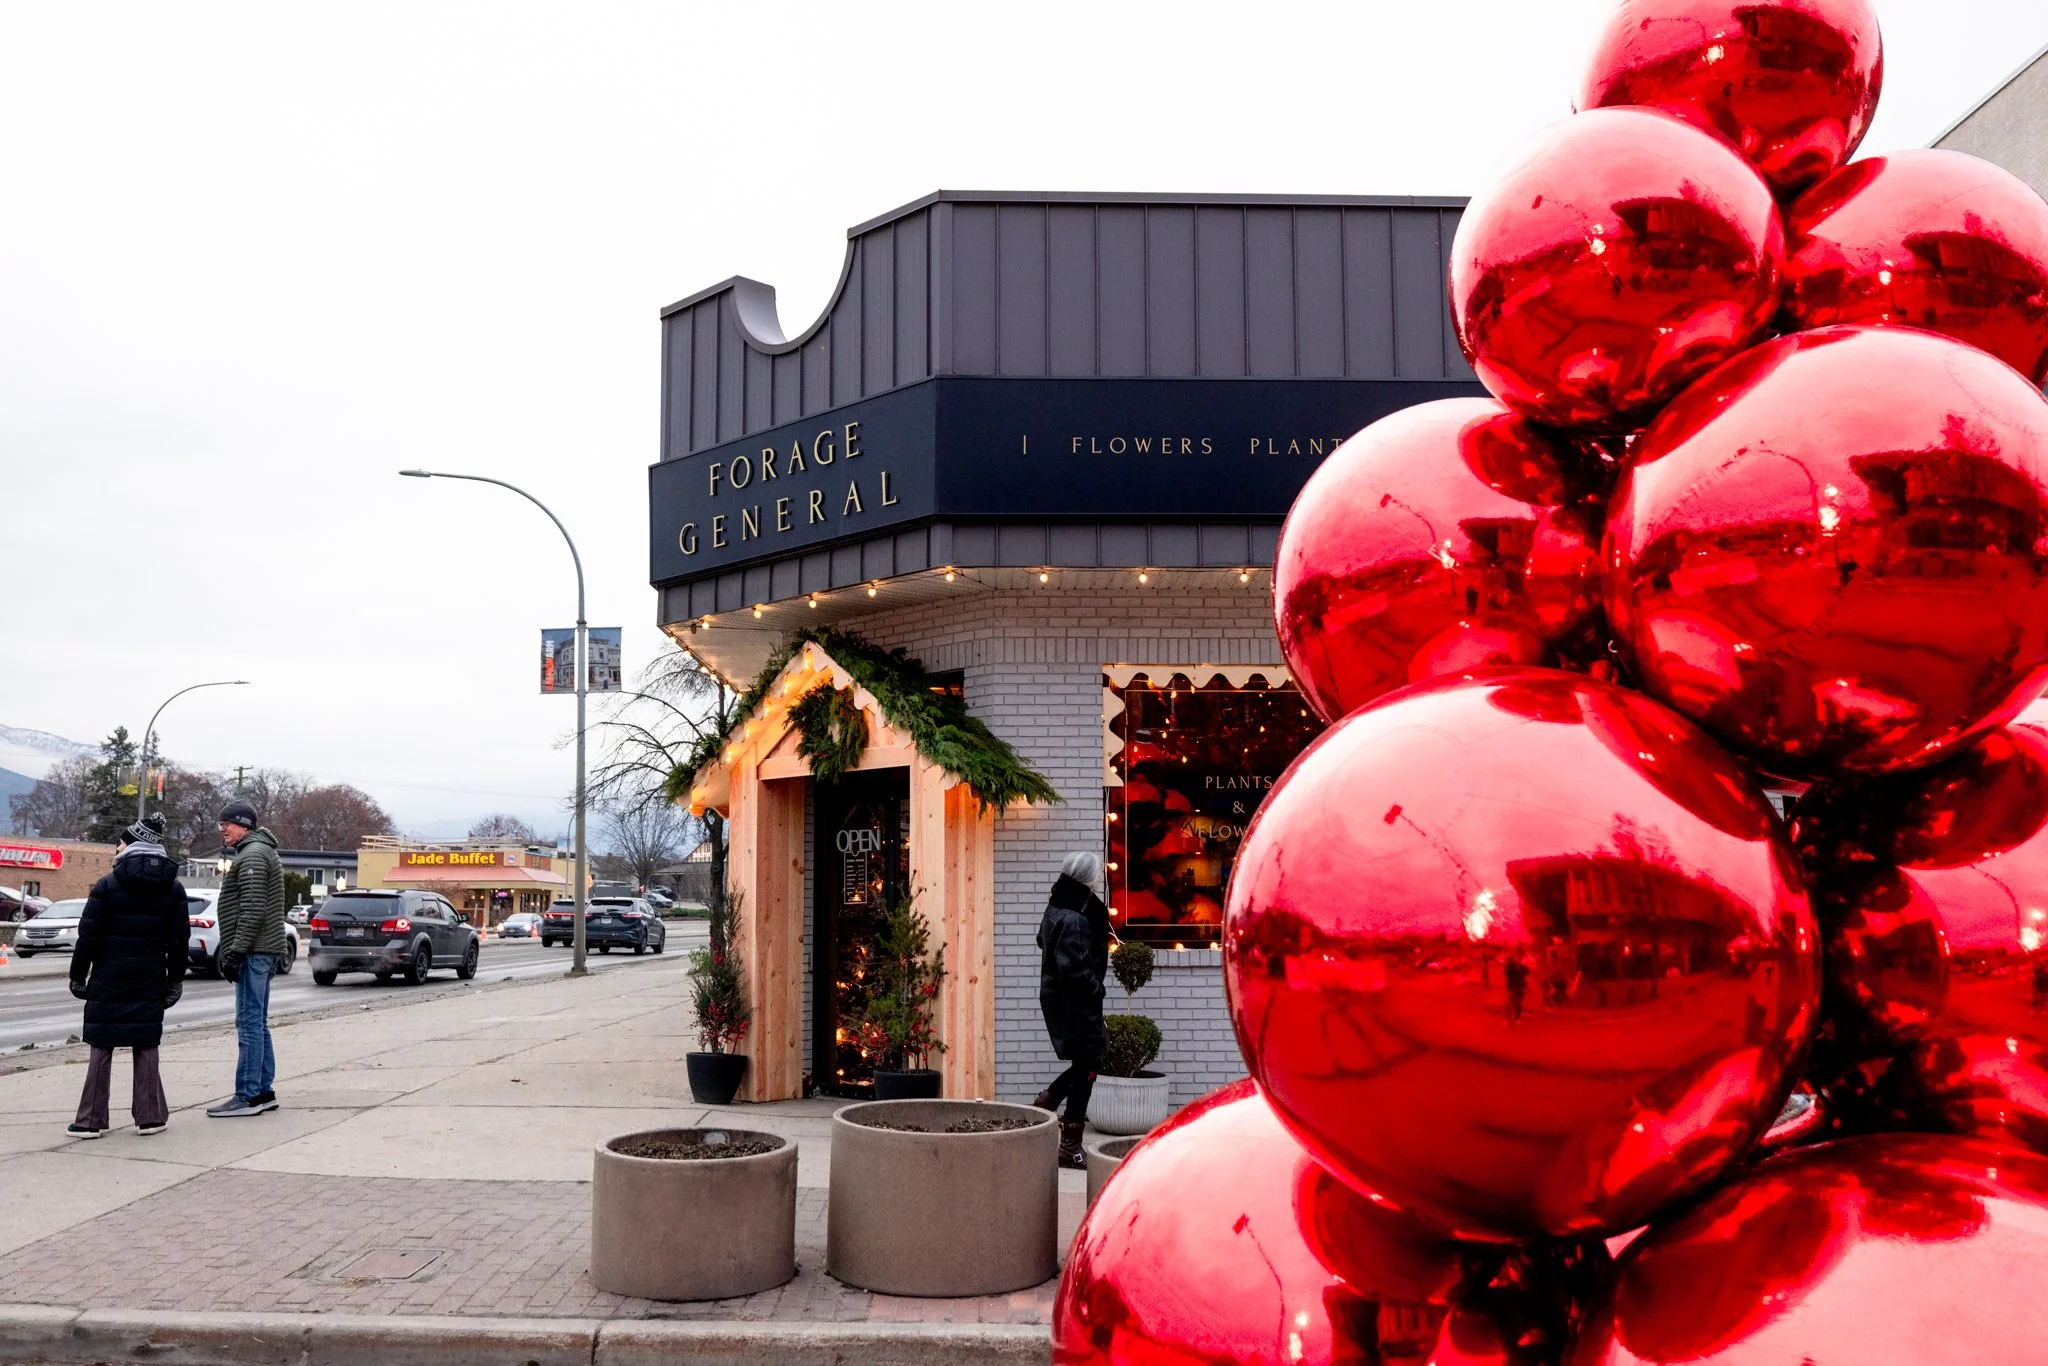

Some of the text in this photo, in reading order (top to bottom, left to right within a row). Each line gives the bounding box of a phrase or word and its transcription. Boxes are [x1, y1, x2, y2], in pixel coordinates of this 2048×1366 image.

[1072, 437, 1213, 454] FLOWERS
[709, 421, 862, 497] FORAGE
[679, 470, 898, 556] GENERAL
[1205, 776, 1272, 789] PLANTS
[1232, 801, 1246, 814] &
[836, 829, 881, 852] OPEN
[407, 853, 445, 865] Jade
[449, 853, 496, 865] Buffet
